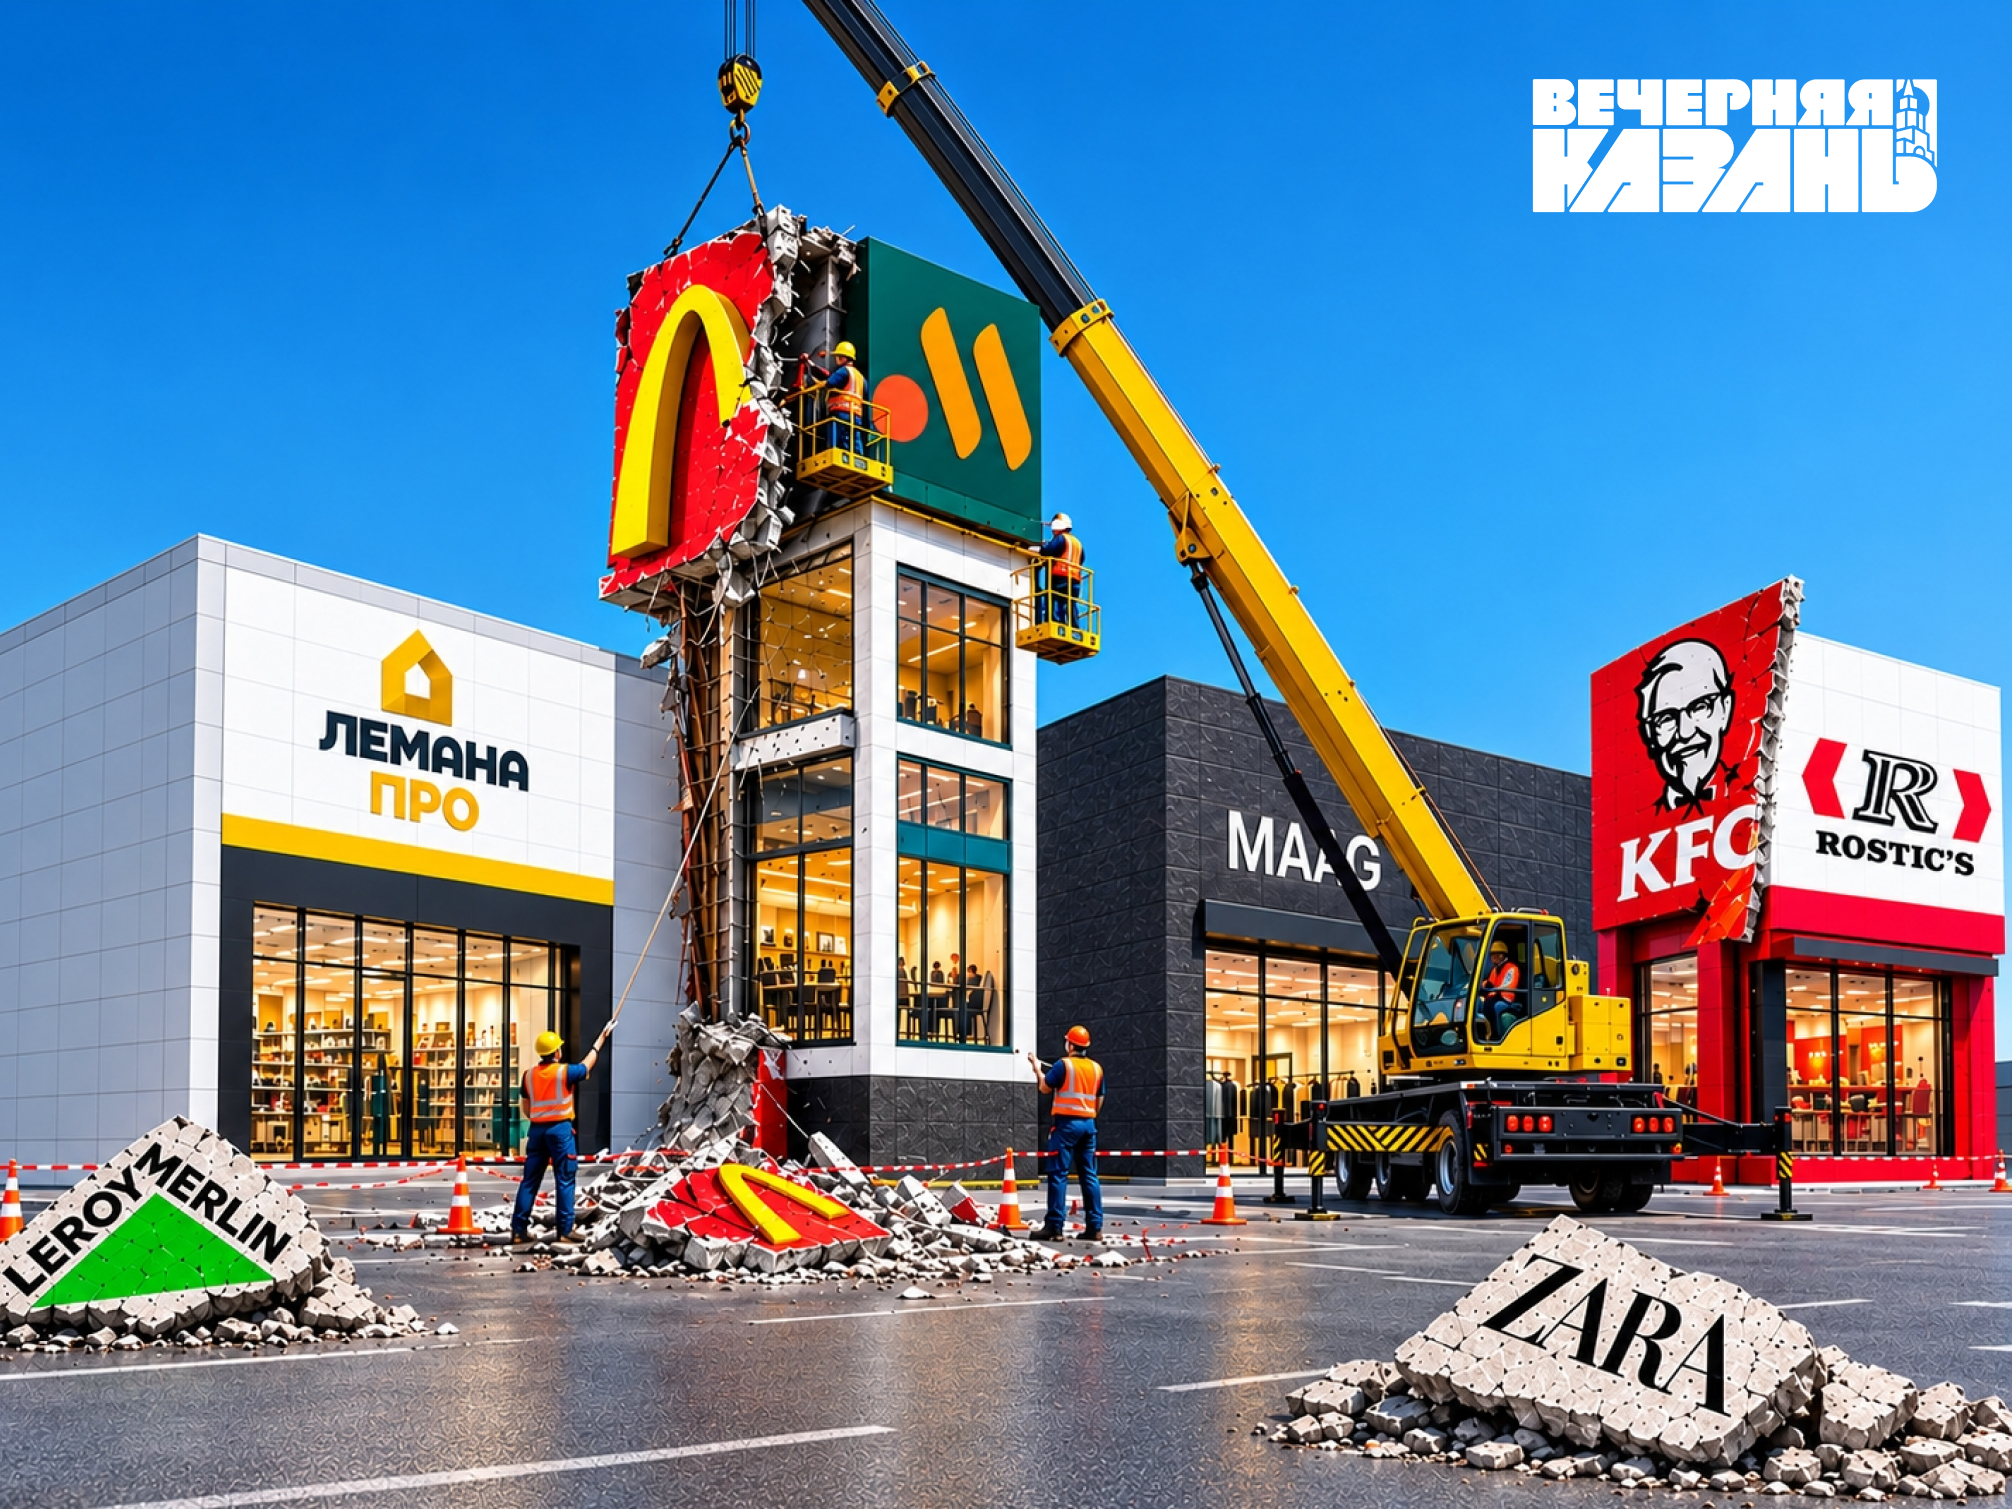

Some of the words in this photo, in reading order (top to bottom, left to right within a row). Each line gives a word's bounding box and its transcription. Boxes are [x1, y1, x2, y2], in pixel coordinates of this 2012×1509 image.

[319, 710, 529, 792] ЛЕМАНА
[1853, 750, 1938, 834] R
[370, 771, 480, 832] ПРО
[1617, 805, 1762, 902] KFC
[1816, 831, 1974, 876] ROSTIC’S
[2, 1166, 143, 1296] LEROY
[134, 1142, 291, 1263] MERLIN
[1483, 1254, 1732, 1417] ZARA
